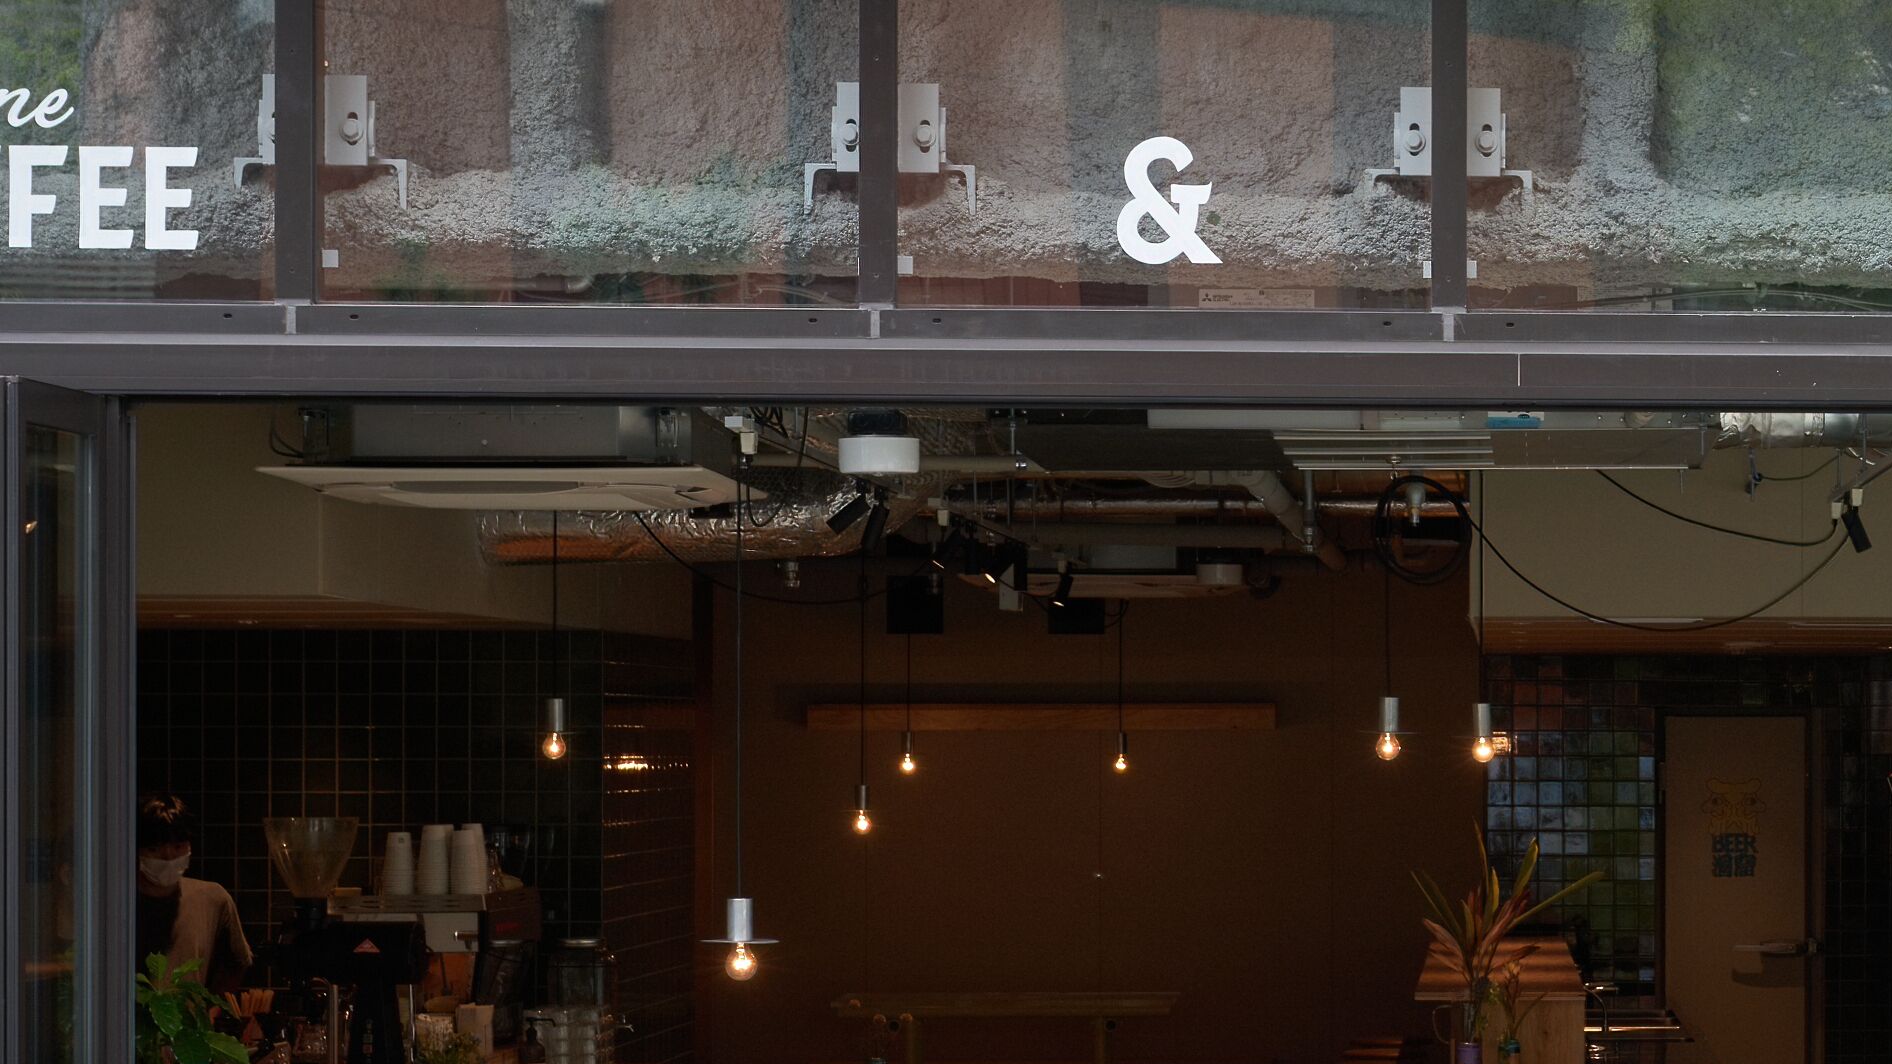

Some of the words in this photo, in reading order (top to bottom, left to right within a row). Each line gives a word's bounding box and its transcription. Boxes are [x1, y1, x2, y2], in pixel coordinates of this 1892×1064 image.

[0, 145, 199, 250] FEE
[1116, 136, 1222, 266] &
[1712, 833, 1760, 854] BEER
